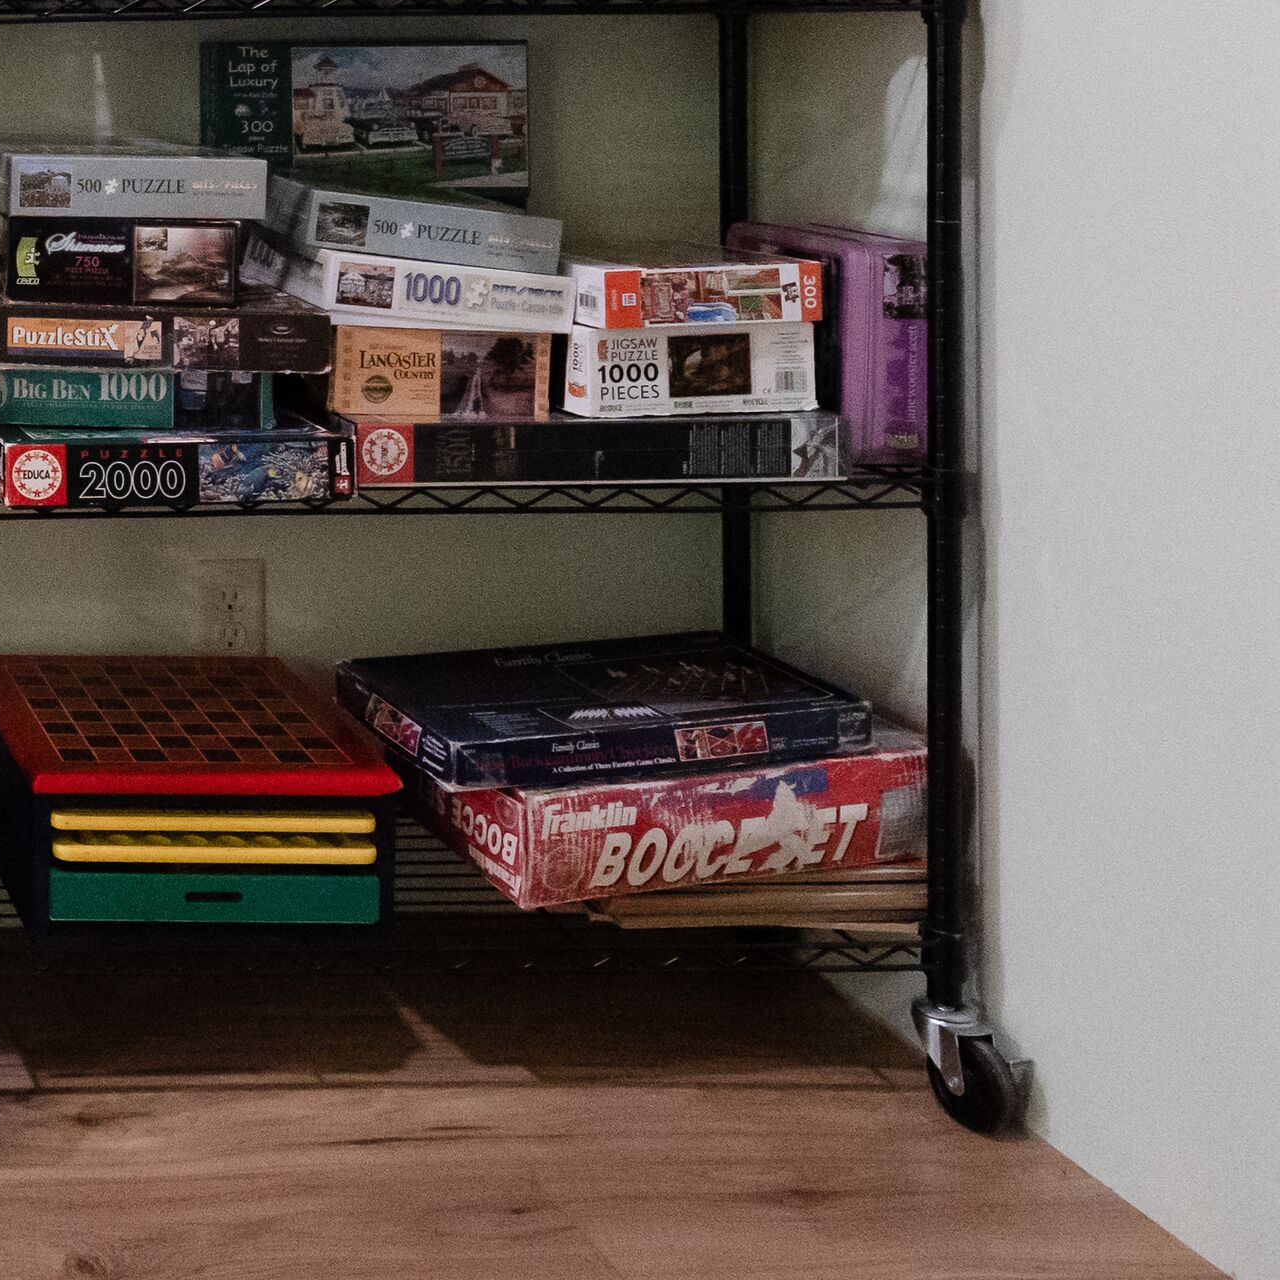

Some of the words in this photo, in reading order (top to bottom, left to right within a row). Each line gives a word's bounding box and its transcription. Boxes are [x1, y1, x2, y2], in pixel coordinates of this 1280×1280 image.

[229, 75, 279, 90] Luxury
[240, 120, 273, 134] 300
[76, 178, 102, 193] 500
[121, 178, 187, 195] PUZZLE
[372, 218, 399, 236] 500
[416, 224, 482, 246] PUZZLE
[75, 256, 100, 267] 750
[404, 272, 462, 307] 1000
[801, 274, 817, 310] 300
[610, 337, 658, 350] JIGSAW
[359, 350, 437, 371] LANCASTER
[571, 342, 580, 372] 1000
[610, 350, 659, 362] PUZZLE
[597, 363, 659, 384] 1000
[97, 373, 168, 402] 1000
[600, 385, 660, 400] PIECES
[21, 469, 52, 480] EDUCA
[79, 461, 186, 500] 2000
[551, 741, 574, 753] Family
[542, 804, 637, 841] Franklin
